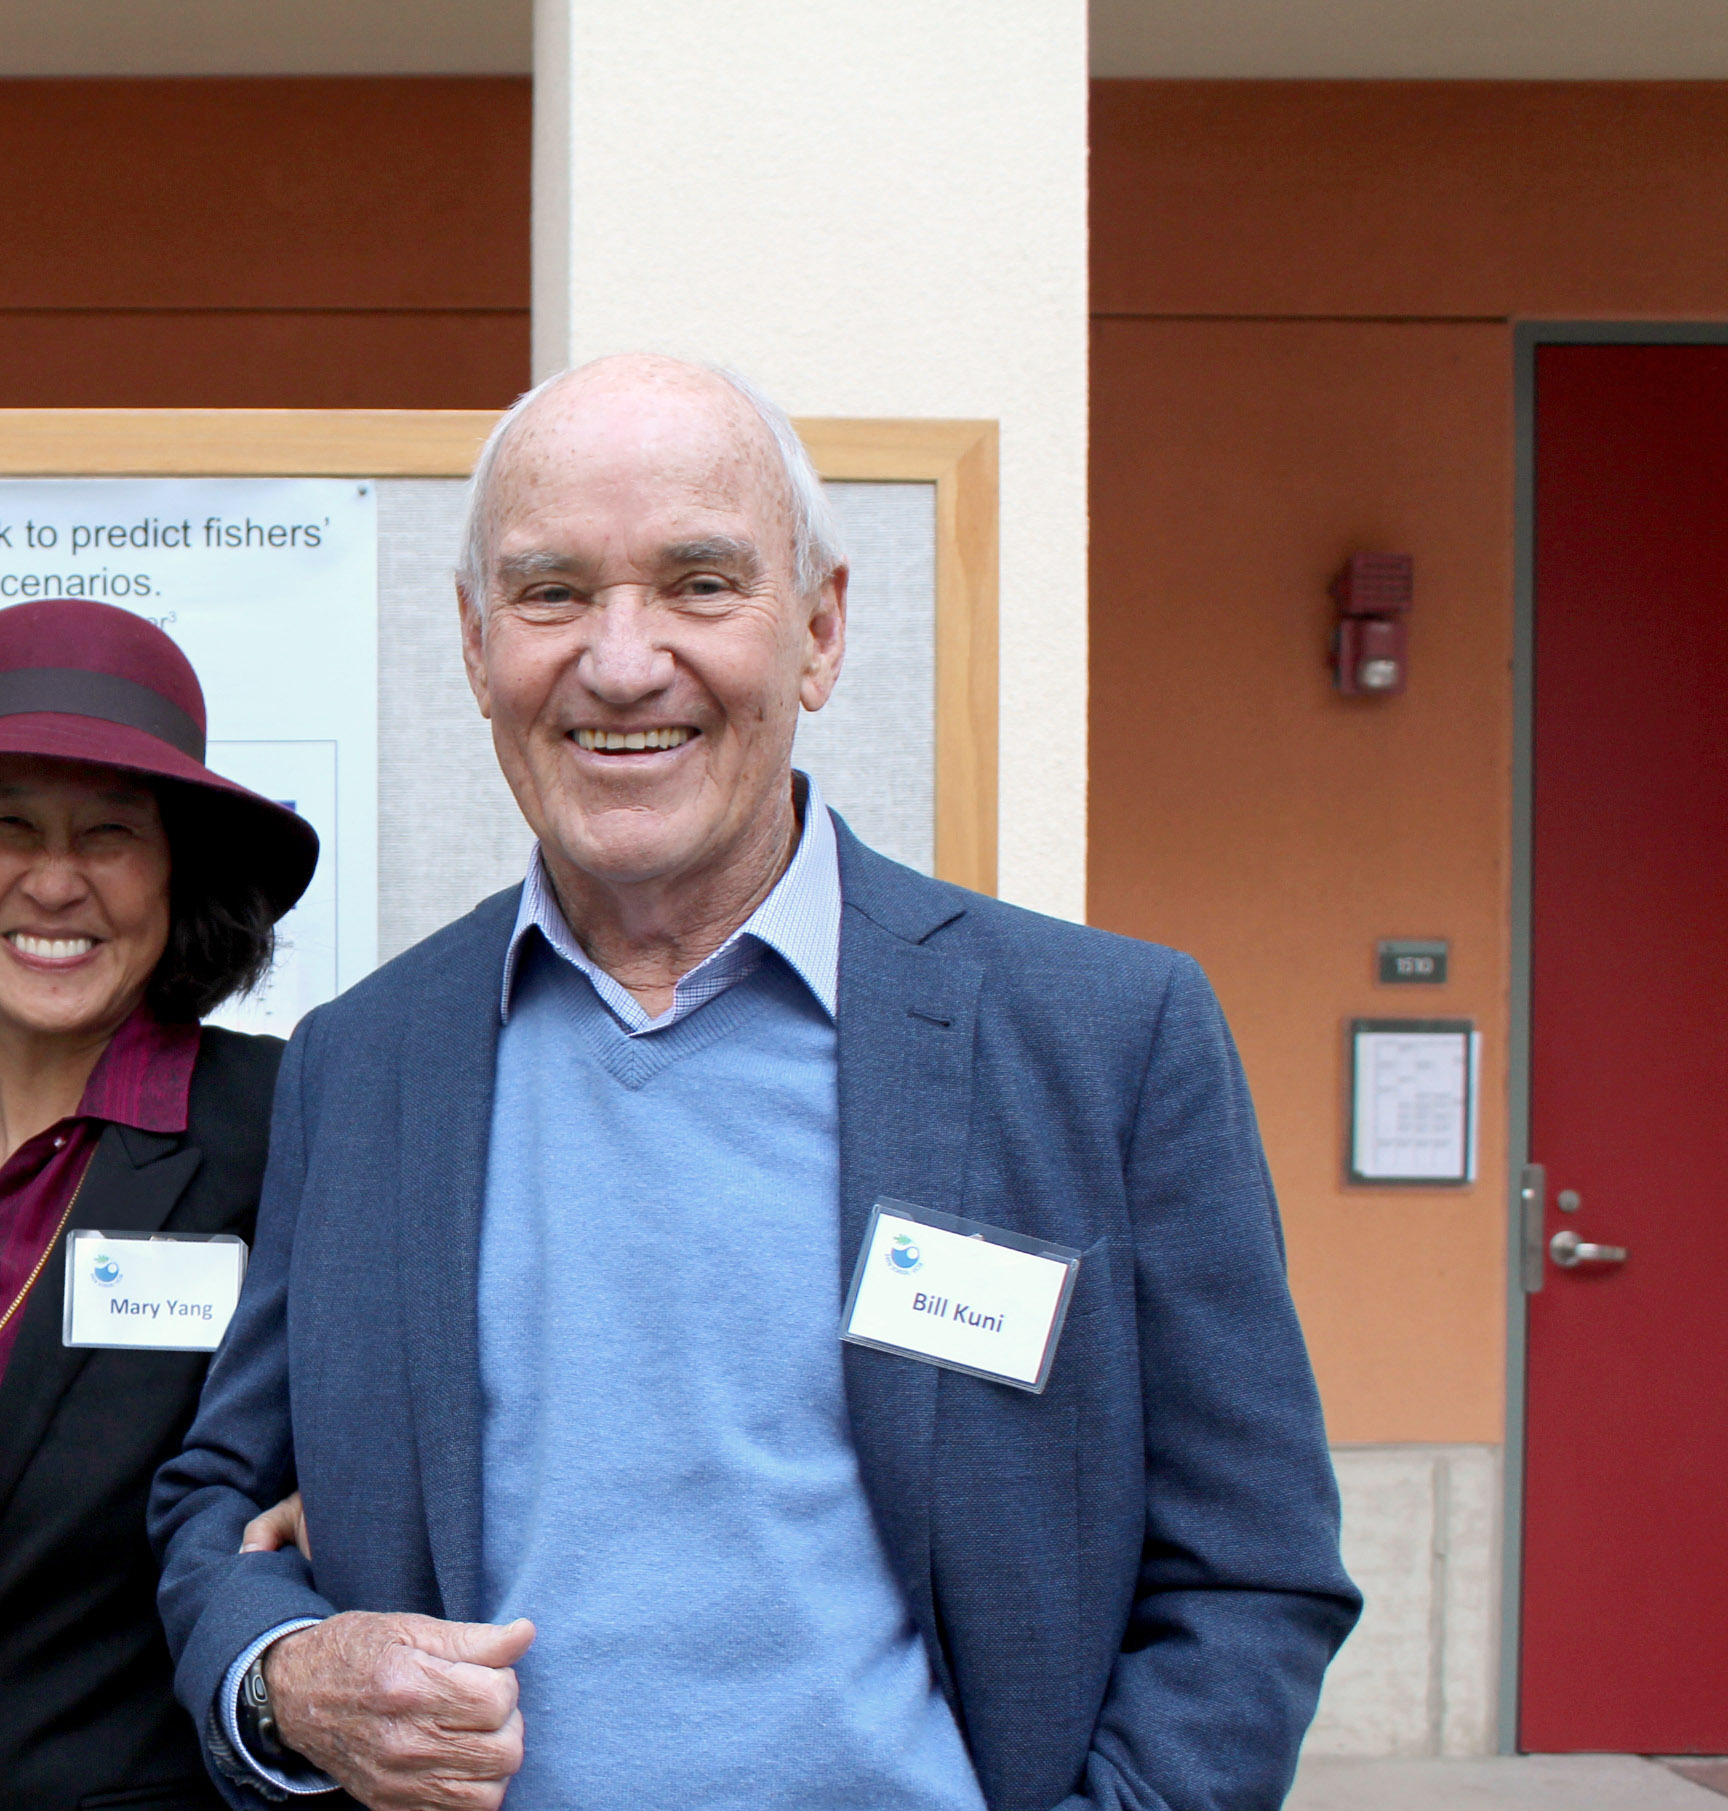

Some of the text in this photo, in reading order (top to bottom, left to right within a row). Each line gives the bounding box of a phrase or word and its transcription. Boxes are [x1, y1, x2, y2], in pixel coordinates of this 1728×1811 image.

[25, 519, 58, 549] to
[72, 517, 191, 555] predict
[1396, 956, 1435, 975] 1510
[110, 1298, 213, 1320] Mary Yang
[912, 1292, 1005, 1333] Bill Kuni
